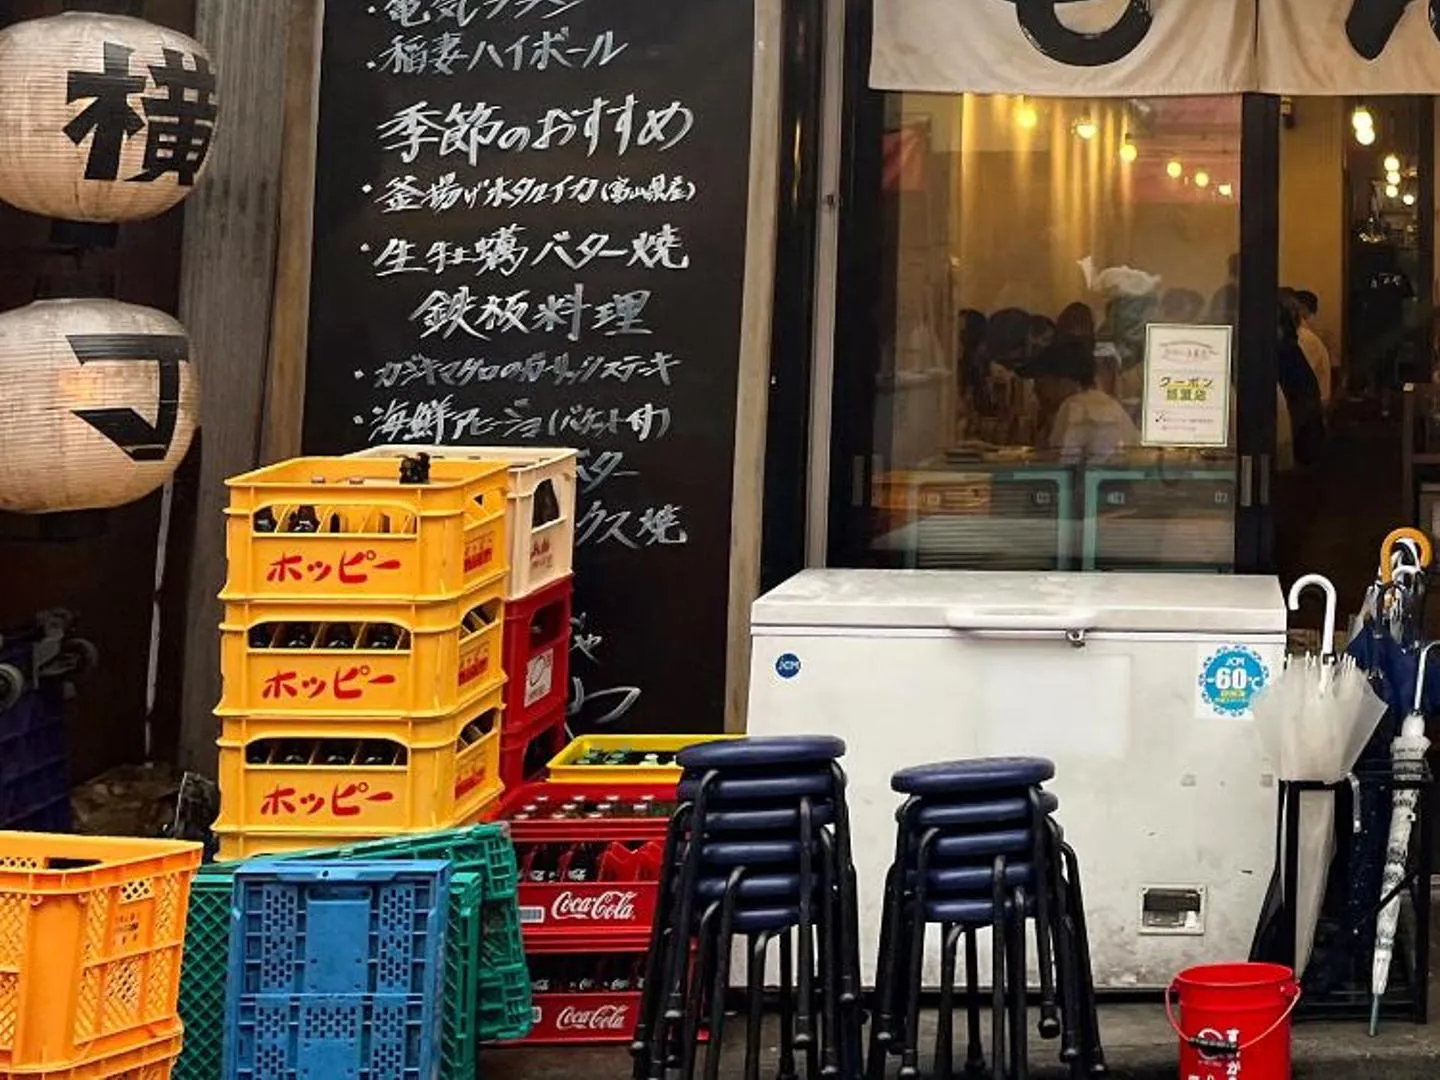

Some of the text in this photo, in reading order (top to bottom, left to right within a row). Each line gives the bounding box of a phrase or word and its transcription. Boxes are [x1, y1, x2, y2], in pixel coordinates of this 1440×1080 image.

[377, 26, 630, 76] 稲妻ハイボール
[375, 93, 695, 167] 季節のおすすめ
[408, 283, 654, 341] 鉄板料理
[266, 549, 401, 584] ホッピー
[262, 665, 396, 700] ホッピー
[260, 781, 394, 817] ホッピー
[551, 890, 638, 920] Coca-Cola
[556, 1004, 629, 1031] Coca-Cola
